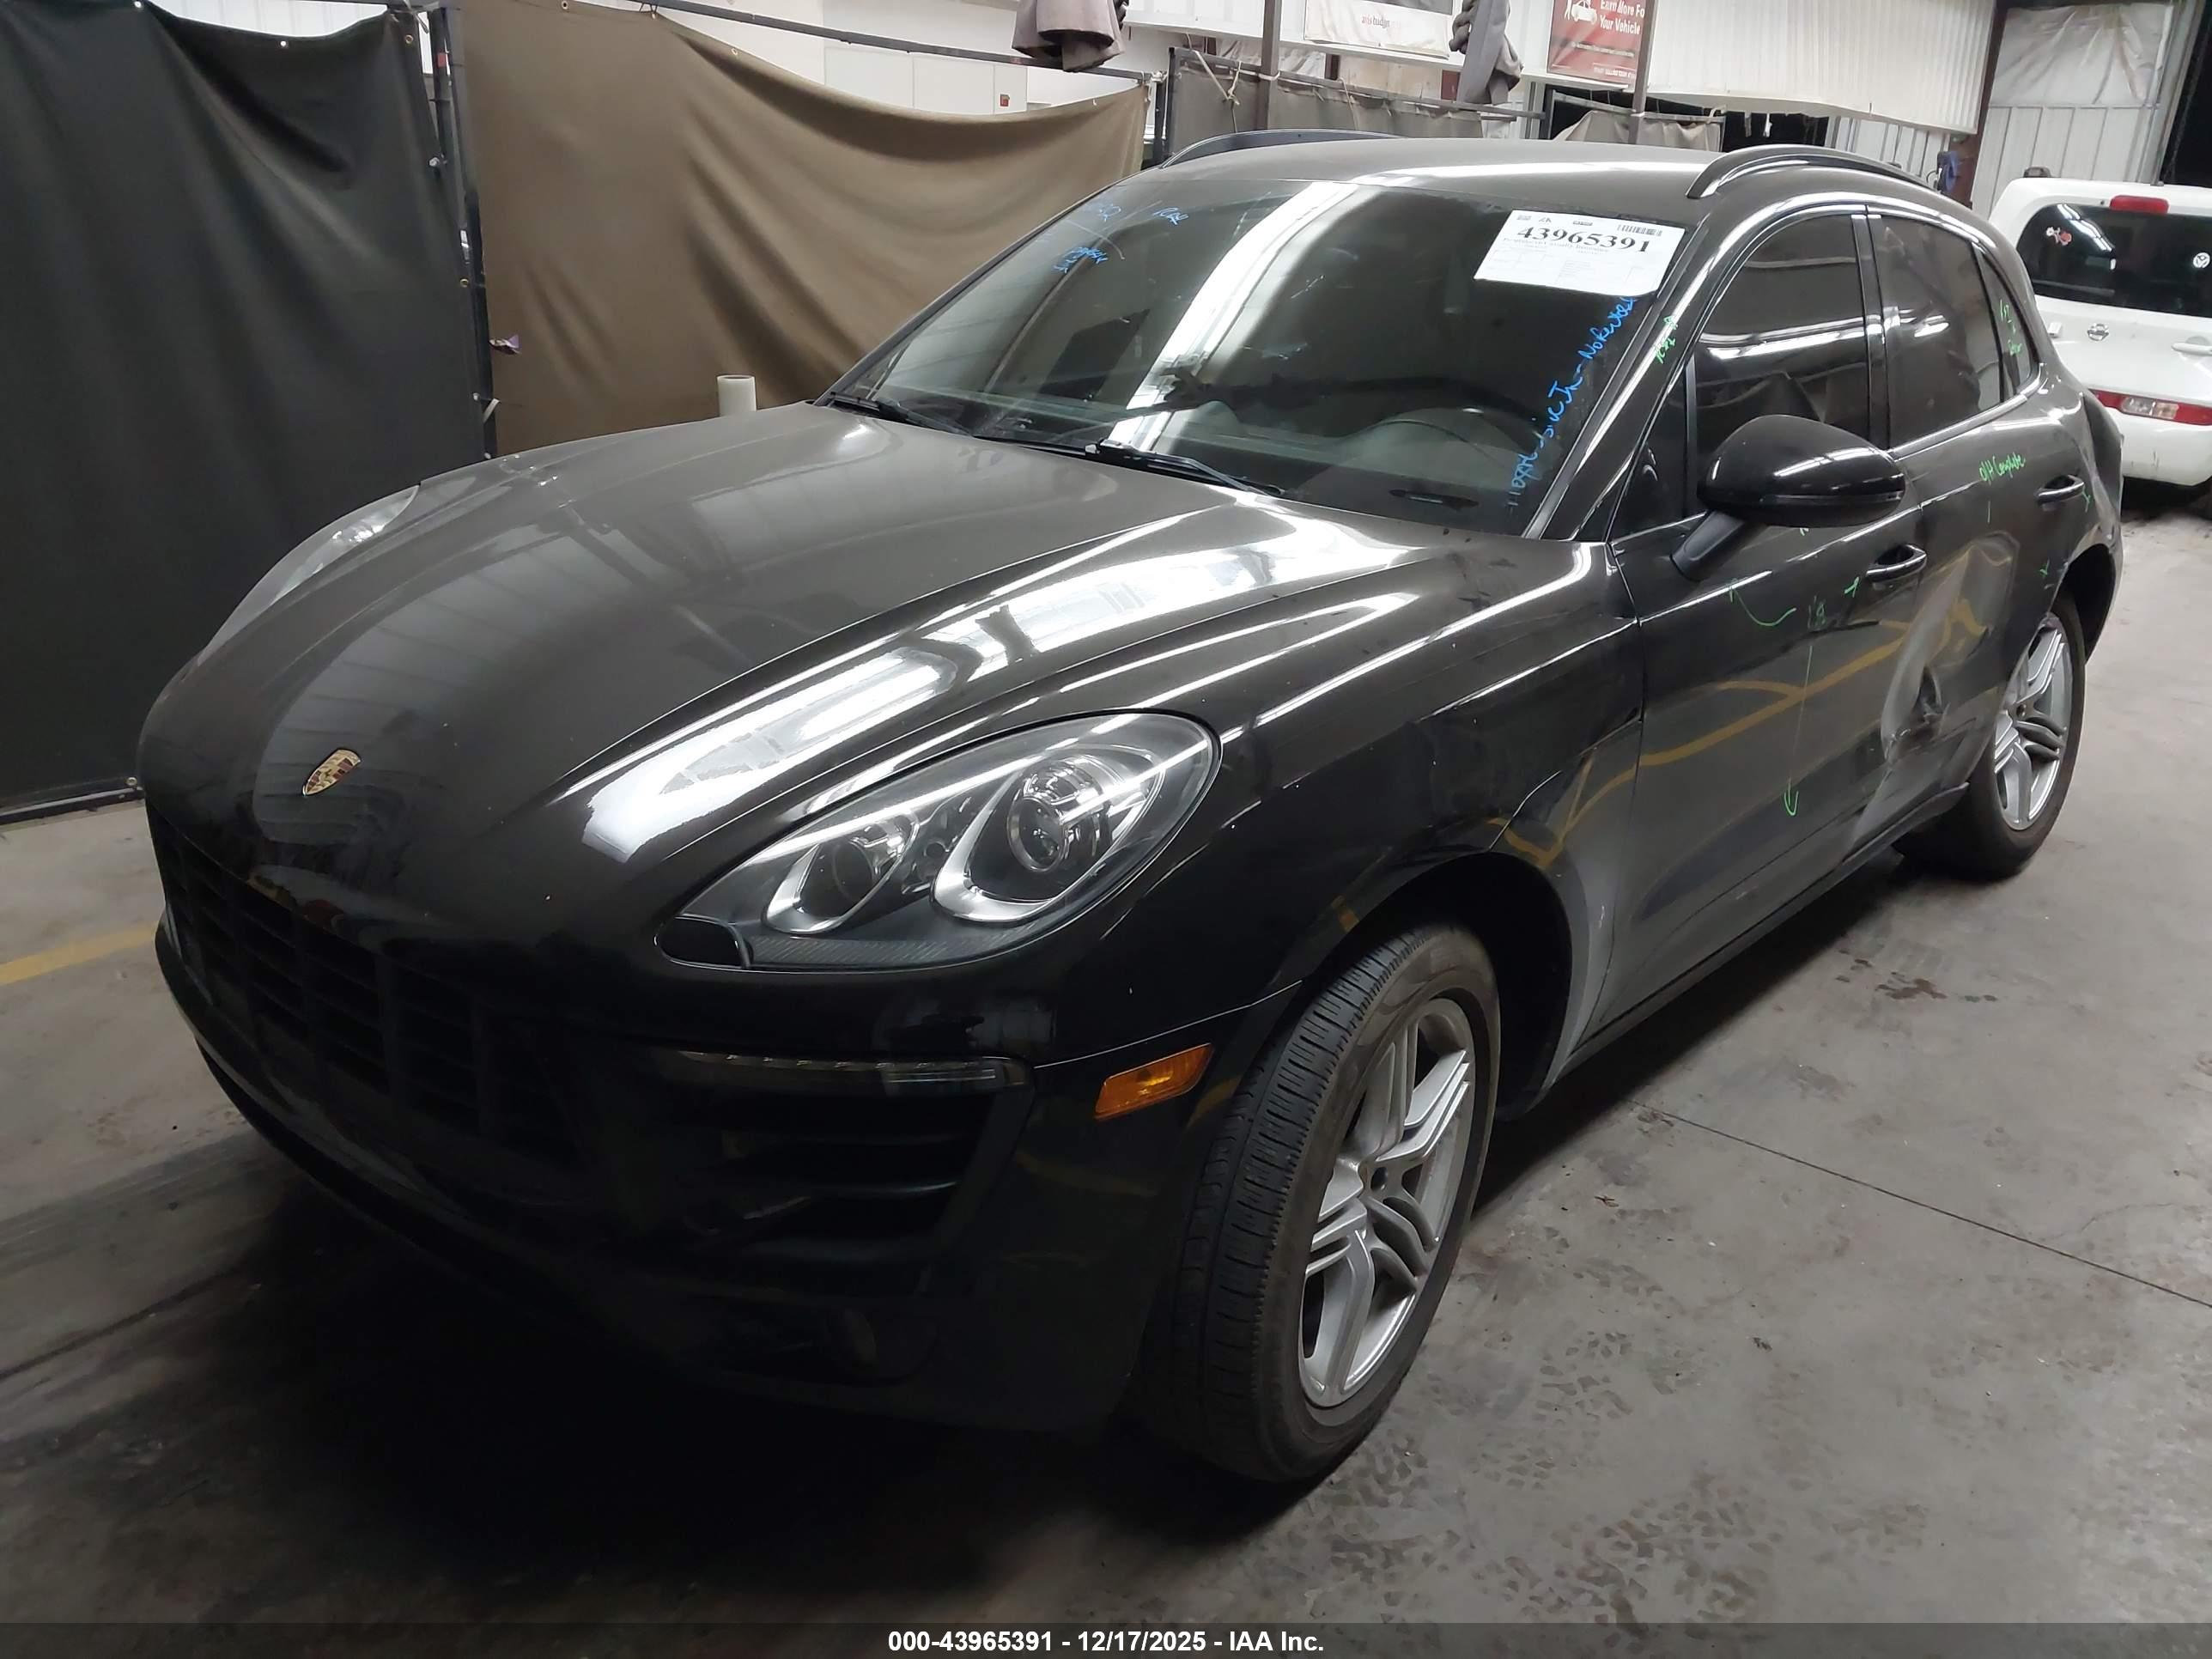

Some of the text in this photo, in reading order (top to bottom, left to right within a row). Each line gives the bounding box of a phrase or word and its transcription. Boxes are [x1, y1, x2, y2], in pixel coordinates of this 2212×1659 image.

[1601, 0, 1618, 12] Earn
[1617, 0, 1635, 15] More
[1600, 15, 1641, 34] Your Vehicle
[1516, 226, 1651, 252] 43965391
